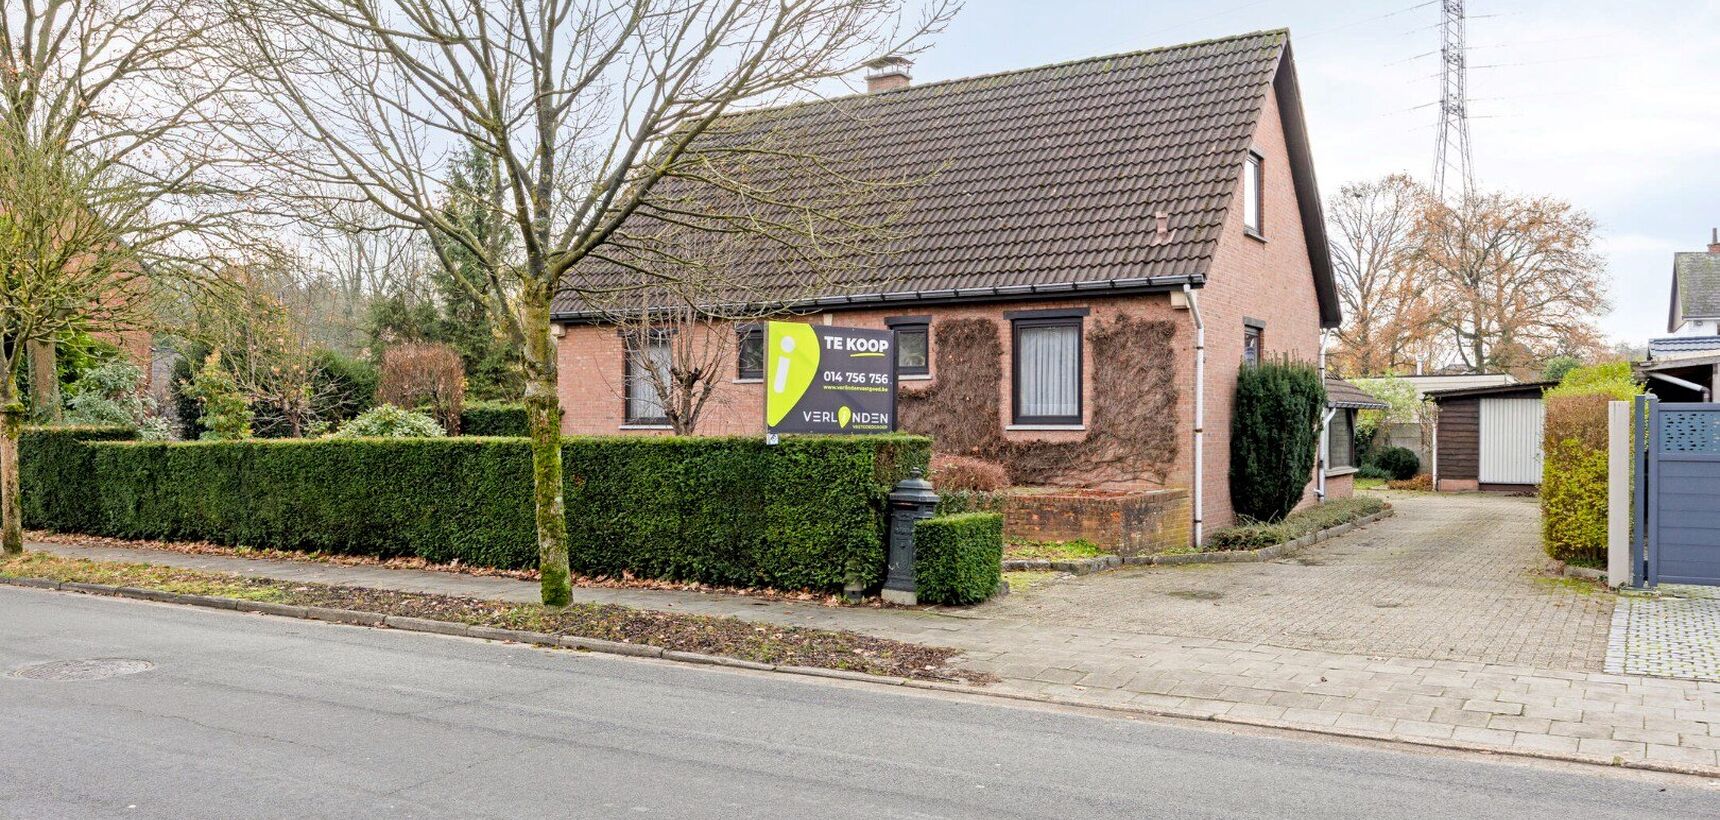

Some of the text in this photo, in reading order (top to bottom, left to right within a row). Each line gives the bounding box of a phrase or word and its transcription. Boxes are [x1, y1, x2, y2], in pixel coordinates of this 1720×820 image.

[824, 336, 889, 353] TE KOOP
[823, 371, 889, 384] 014 756 756
